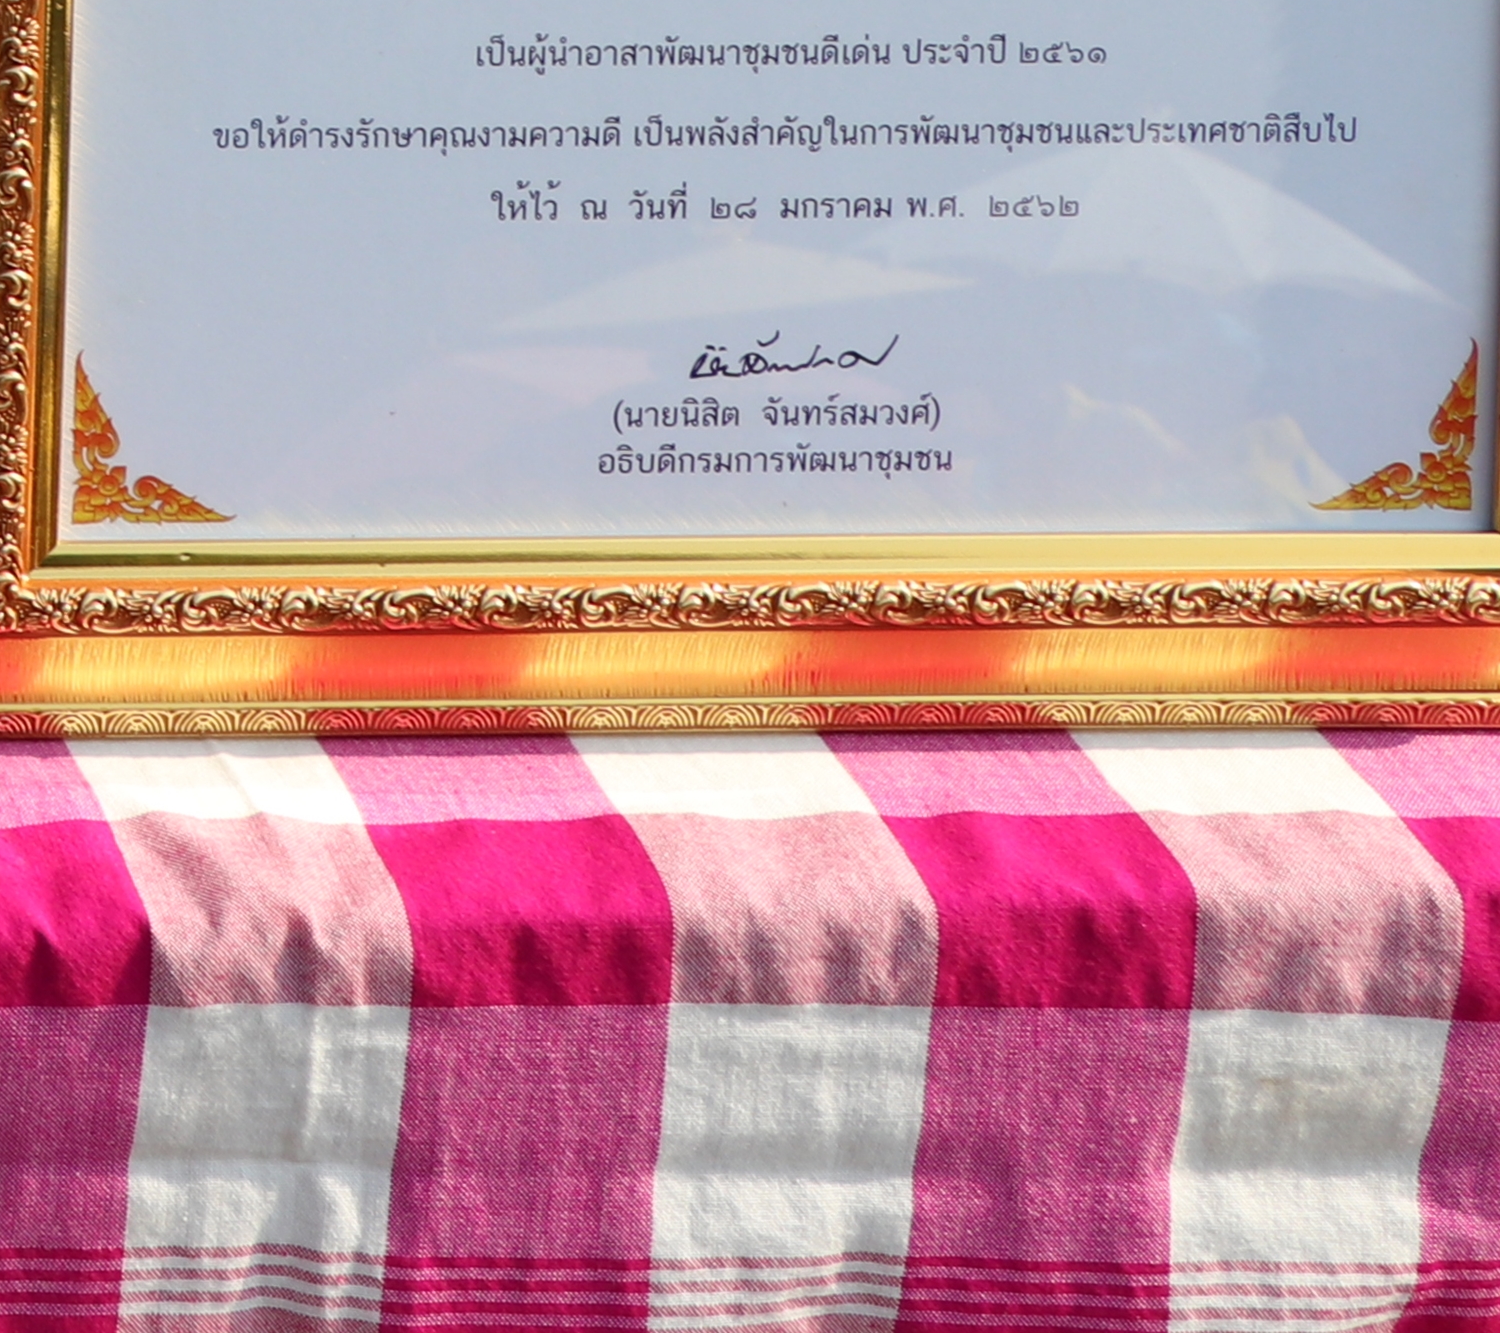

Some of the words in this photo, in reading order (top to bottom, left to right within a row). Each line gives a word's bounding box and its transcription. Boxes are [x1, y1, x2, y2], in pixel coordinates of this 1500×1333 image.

[901, 33, 1007, 65] ประจำปี
[1018, 41, 1108, 64] ๒๕๖๑
[490, 179, 562, 222] ให้ไว้
[579, 198, 608, 221] ณ
[628, 180, 688, 221] วันที่
[710, 196, 758, 220] ๒๘
[779, 196, 893, 220] มกราคม
[906, 195, 965, 218] พ.ศ.
[988, 194, 1080, 218] ๒๕๖๒
[612, 396, 740, 436] (นายนิสิต
[761, 391, 941, 432] จันทร์สมวงศ์)
